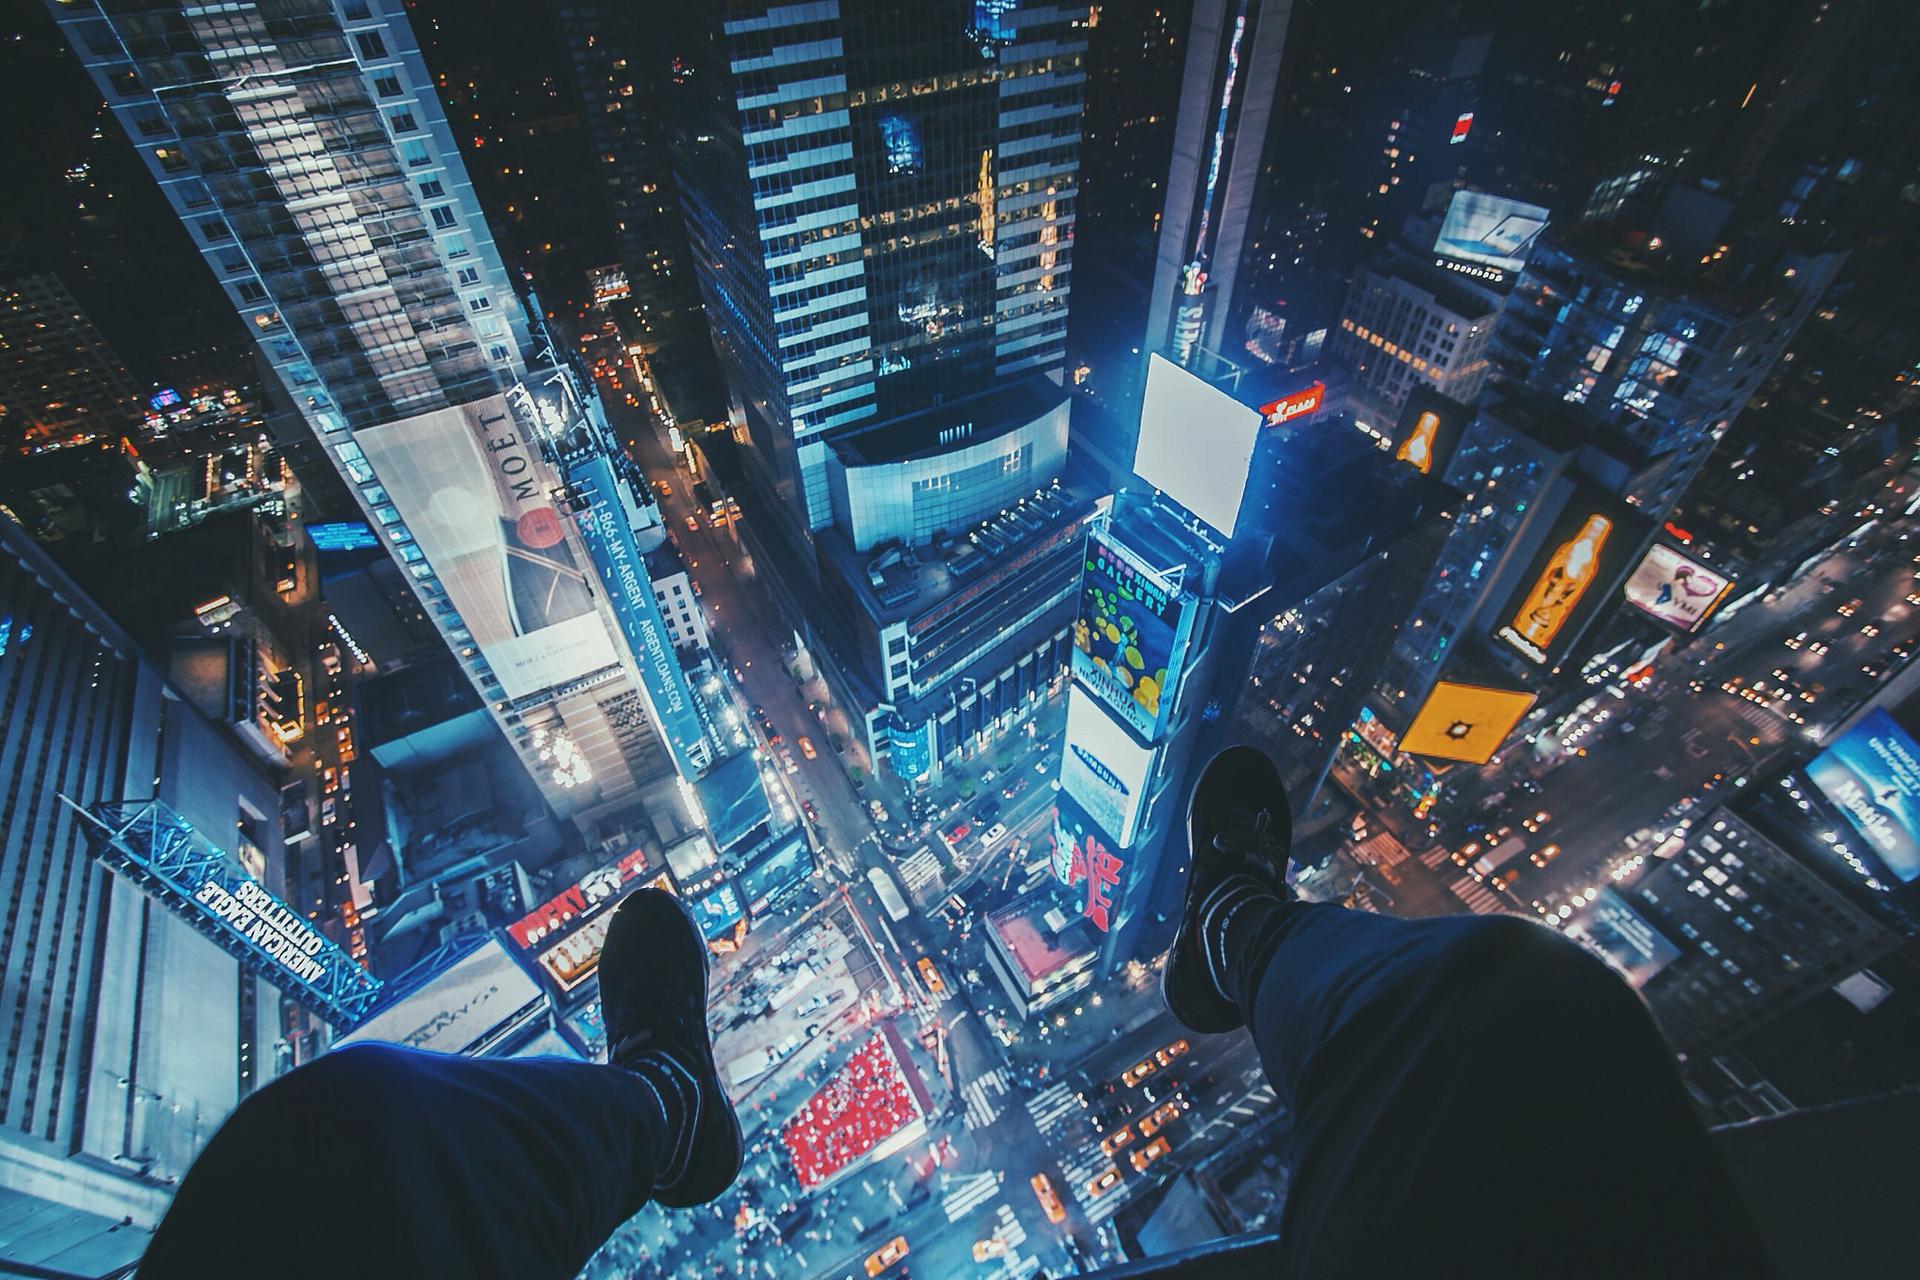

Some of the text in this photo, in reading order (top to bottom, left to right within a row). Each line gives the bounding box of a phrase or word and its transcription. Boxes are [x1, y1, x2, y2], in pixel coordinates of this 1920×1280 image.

[478, 412, 540, 502] MOËT
[592, 499, 684, 714] 1-866-MY-ARGENT ARGENTLOANS.COM
[1097, 557, 1166, 617] GALLERY
[1134, 571, 1167, 606] XINHUA
[1089, 663, 1137, 716] XINHUA
[1105, 688, 1147, 732] AGENCY
[1077, 746, 1123, 793] SAMSUNG
[1867, 735, 1920, 797] UNFORGET
[1833, 779, 1898, 851] Matilda
[195, 880, 326, 985] AMERICAN EAGLE
[234, 880, 324, 957] OUTFITTERS
[412, 1003, 469, 1048] ALAXY
